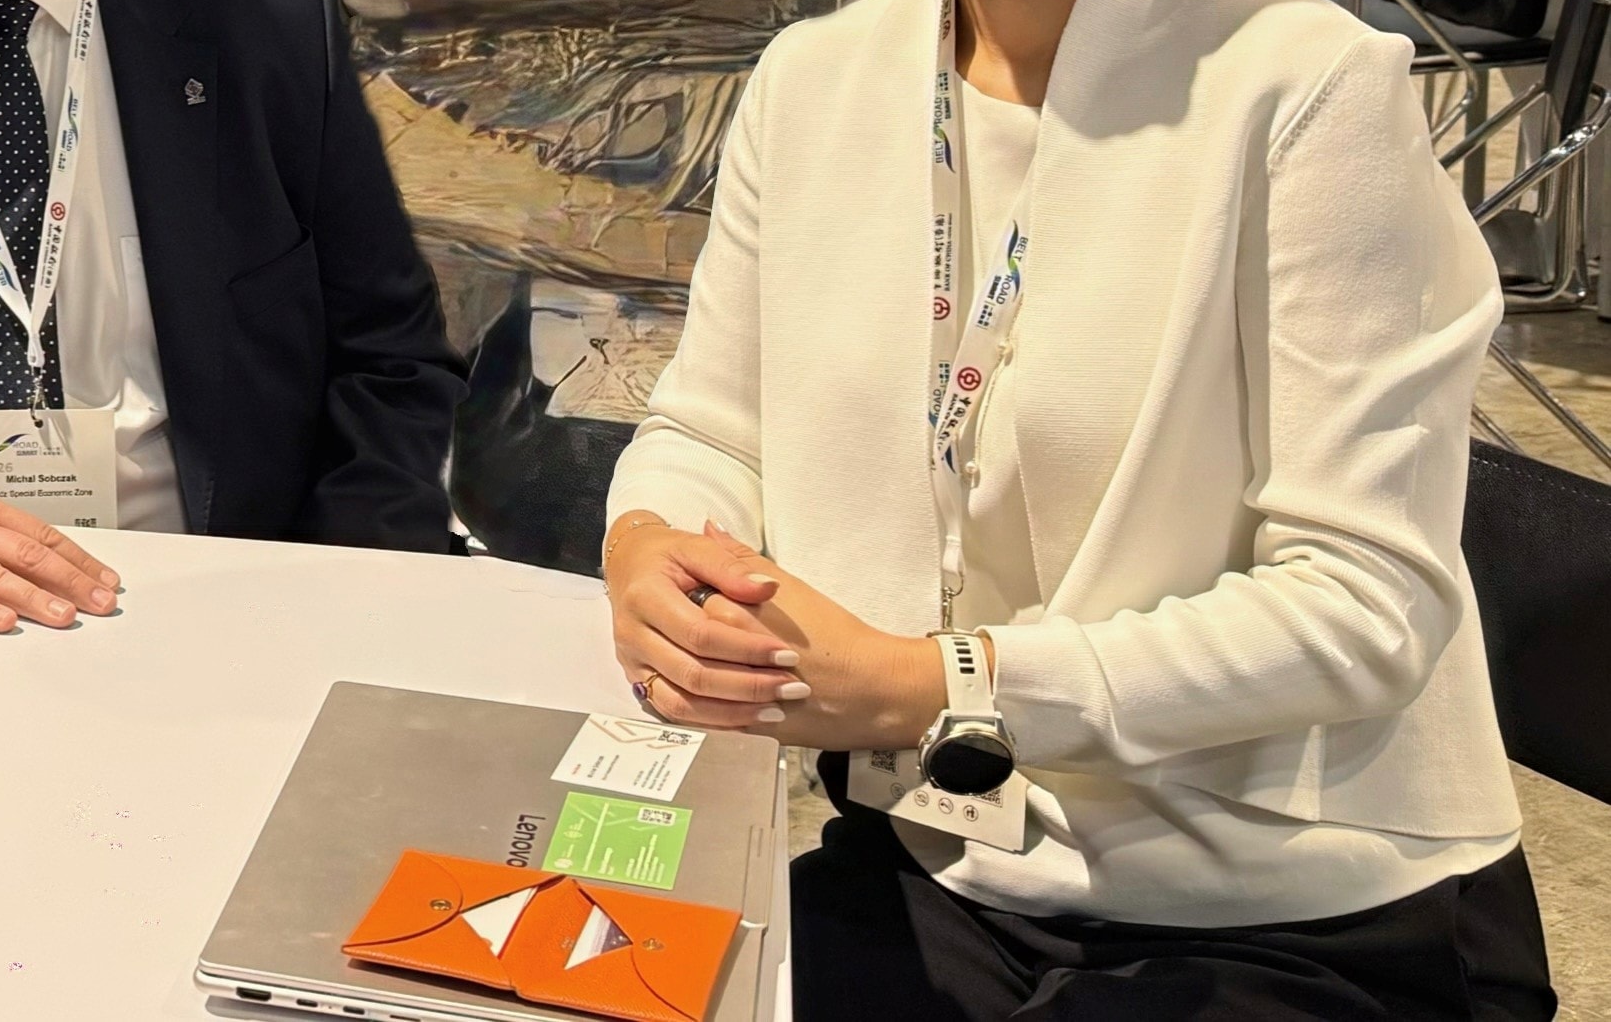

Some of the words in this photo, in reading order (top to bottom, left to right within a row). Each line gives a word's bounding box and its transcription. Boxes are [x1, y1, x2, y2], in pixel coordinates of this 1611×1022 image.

[934, 97, 943, 125] ROAD
[934, 139, 944, 164] BELT
[1015, 236, 1028, 262] BELT
[996, 274, 1012, 305] ROAD
[6, 474, 35, 483] Michal
[38, 474, 77, 483] Sobczak
[10, 490, 36, 498] Special
[38, 489, 72, 497] Economic
[74, 488, 93, 496] Zone
[506, 814, 546, 868] Lenovo
